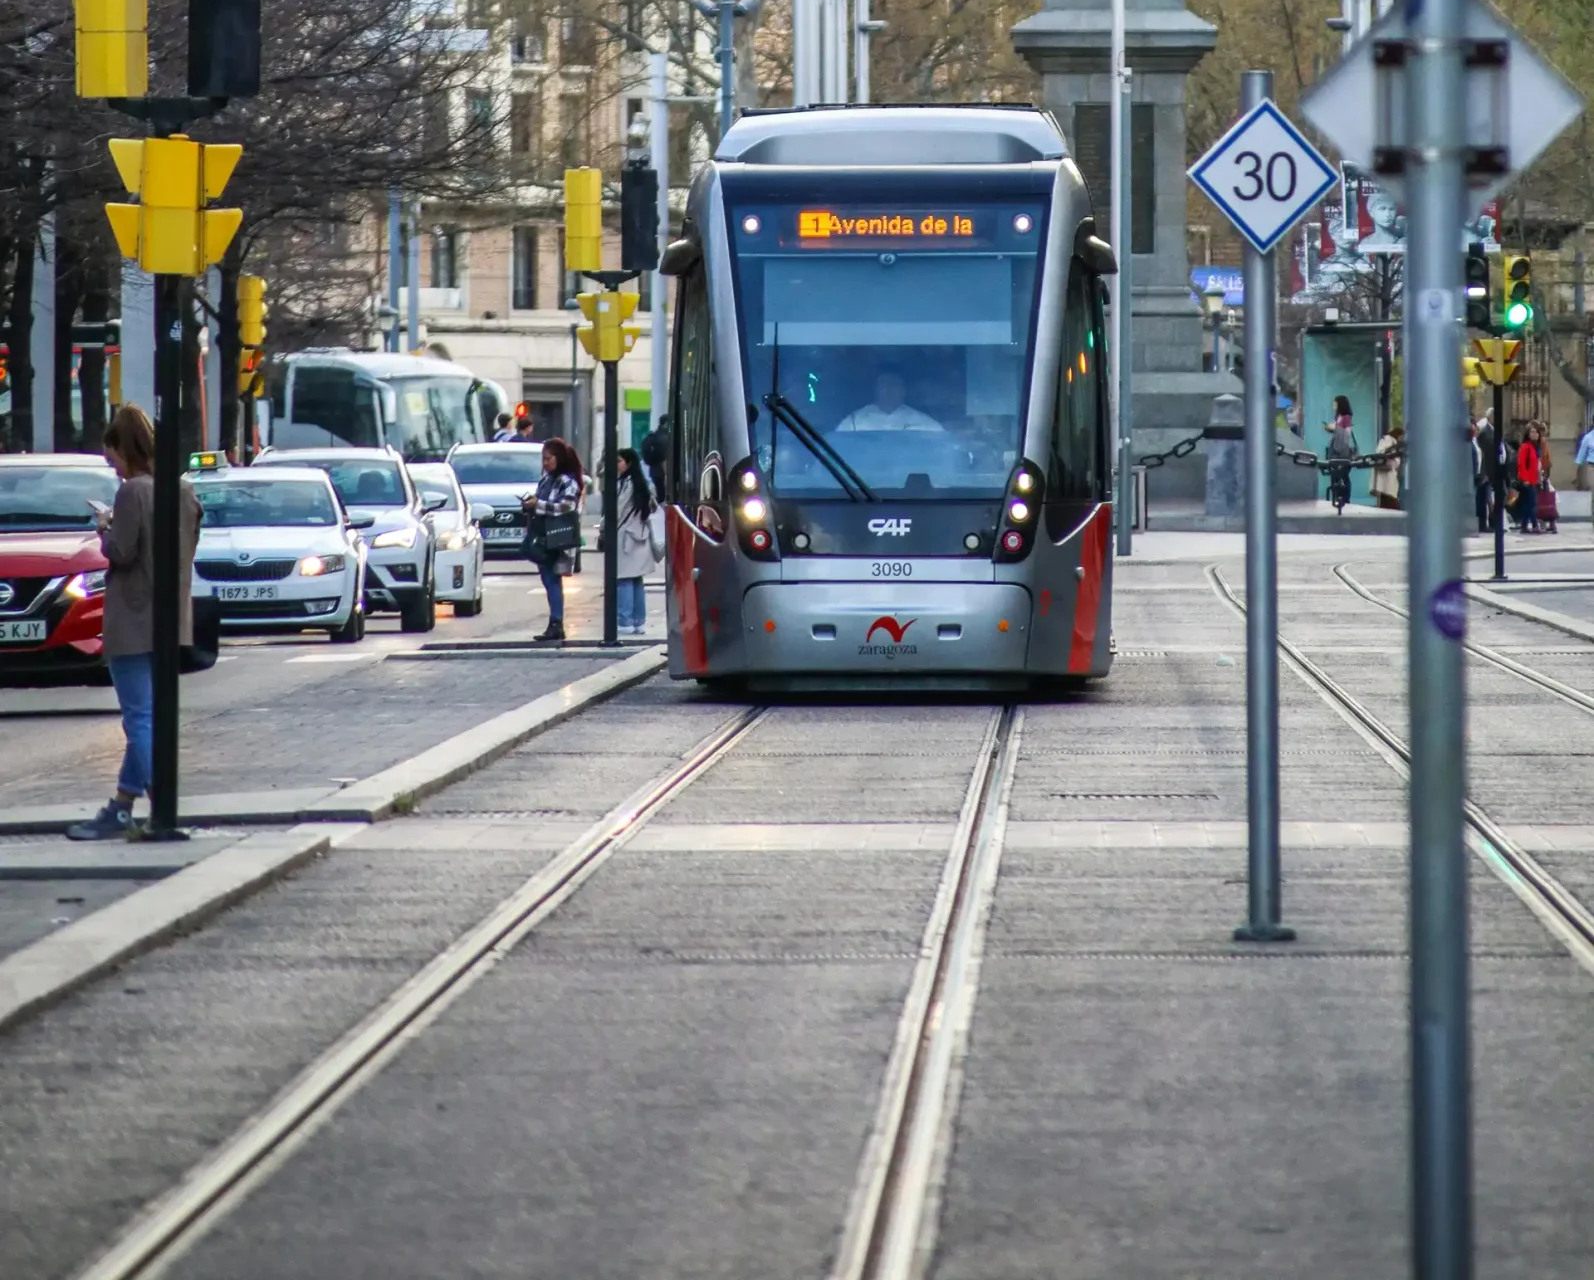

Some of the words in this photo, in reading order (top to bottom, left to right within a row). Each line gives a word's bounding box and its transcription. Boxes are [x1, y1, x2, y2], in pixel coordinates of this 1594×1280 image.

[1233, 150, 1297, 202] 30
[829, 215, 914, 235] Avenida
[920, 215, 947, 235] de
[954, 215, 972, 235] la
[867, 518, 912, 537] CAF
[871, 562, 912, 577] 3090
[221, 587, 249, 599] 1673
[252, 587, 274, 599] JPS
[12, 623, 40, 637] KJY
[857, 643, 918, 660] zaragoza
